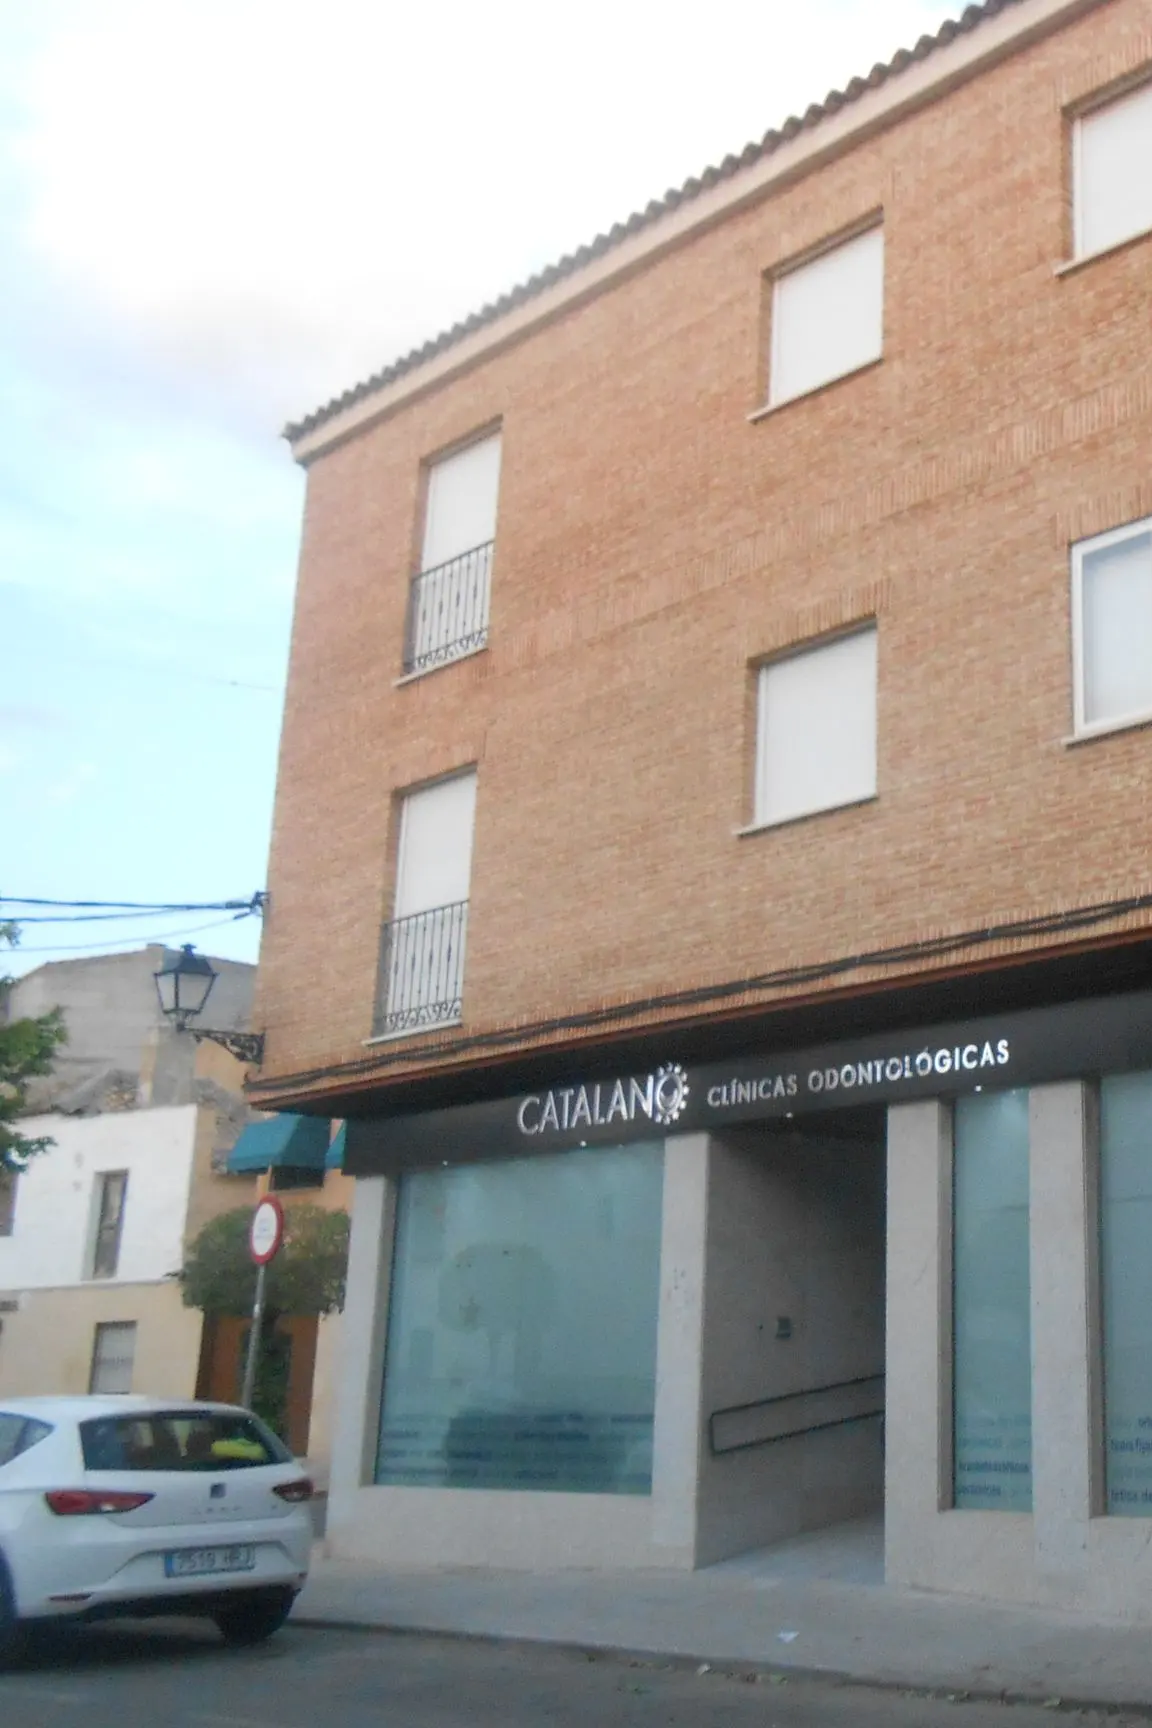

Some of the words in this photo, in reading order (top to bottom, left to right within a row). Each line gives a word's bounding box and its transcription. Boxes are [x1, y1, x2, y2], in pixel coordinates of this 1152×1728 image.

[517, 1063, 690, 1136] CATALANO
[707, 1074, 798, 1107] CLÍNICAS
[807, 1039, 1010, 1092] ODONTOLÓGICAS
